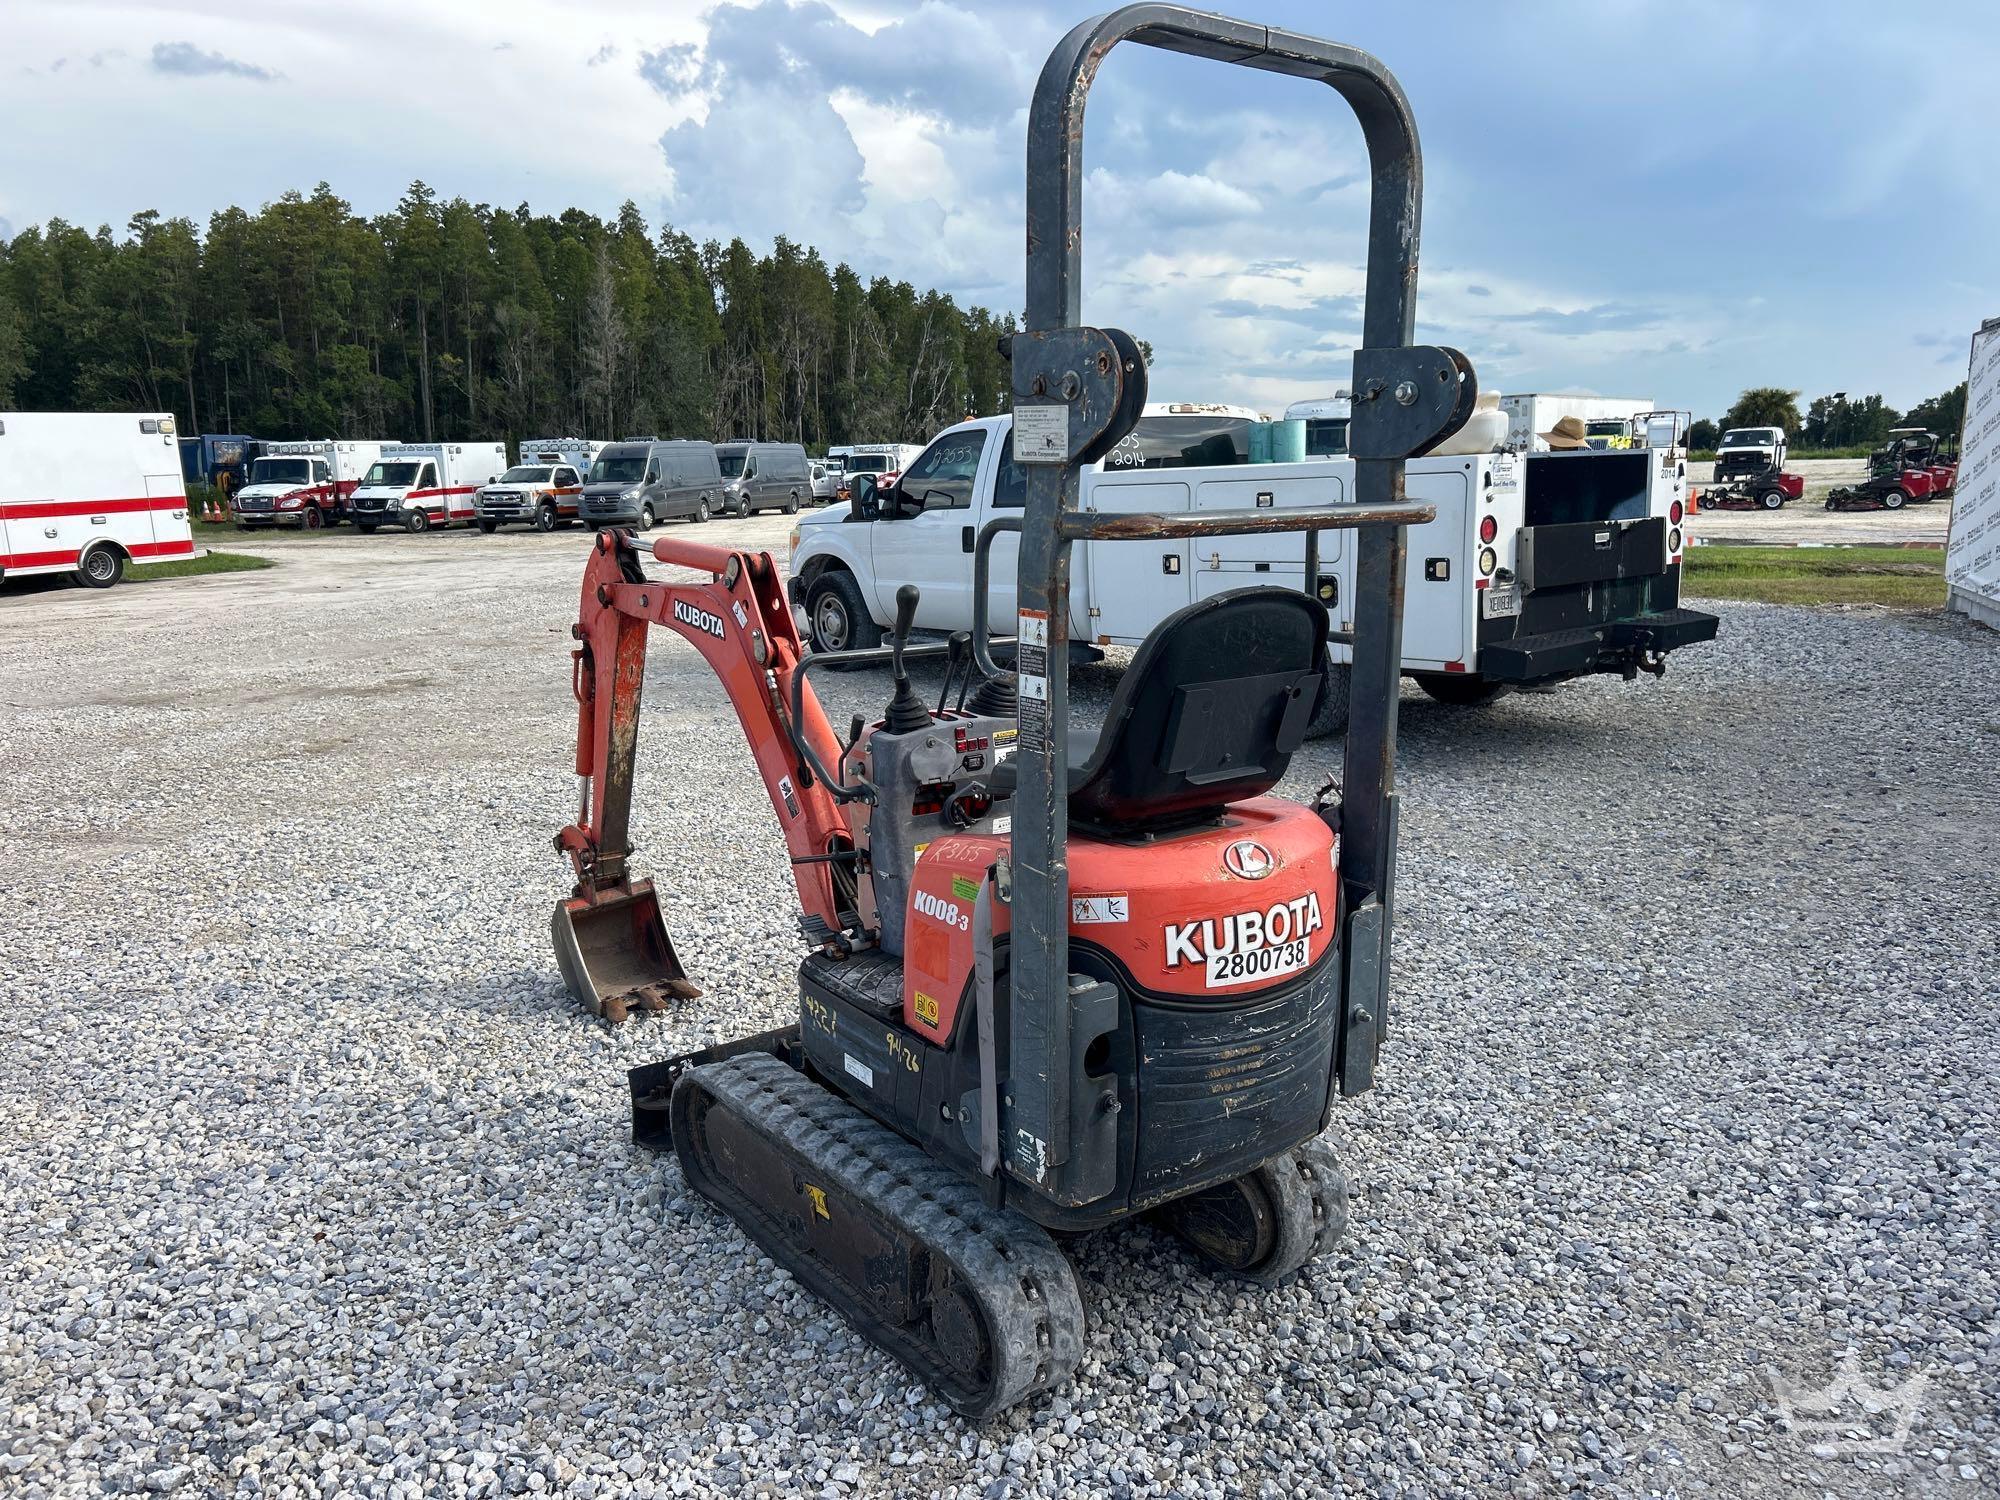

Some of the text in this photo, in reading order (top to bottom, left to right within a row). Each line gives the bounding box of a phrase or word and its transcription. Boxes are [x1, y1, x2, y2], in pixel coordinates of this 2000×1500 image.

[1112, 449, 1146, 467] 2014
[1660, 469, 1676, 479] 2014
[674, 600, 725, 639] KUBOTA
[929, 839, 991, 863] K3155
[914, 889, 969, 931] K008-3
[1165, 892, 1323, 966] KUBOTA
[1214, 940, 1305, 980] 2800738
